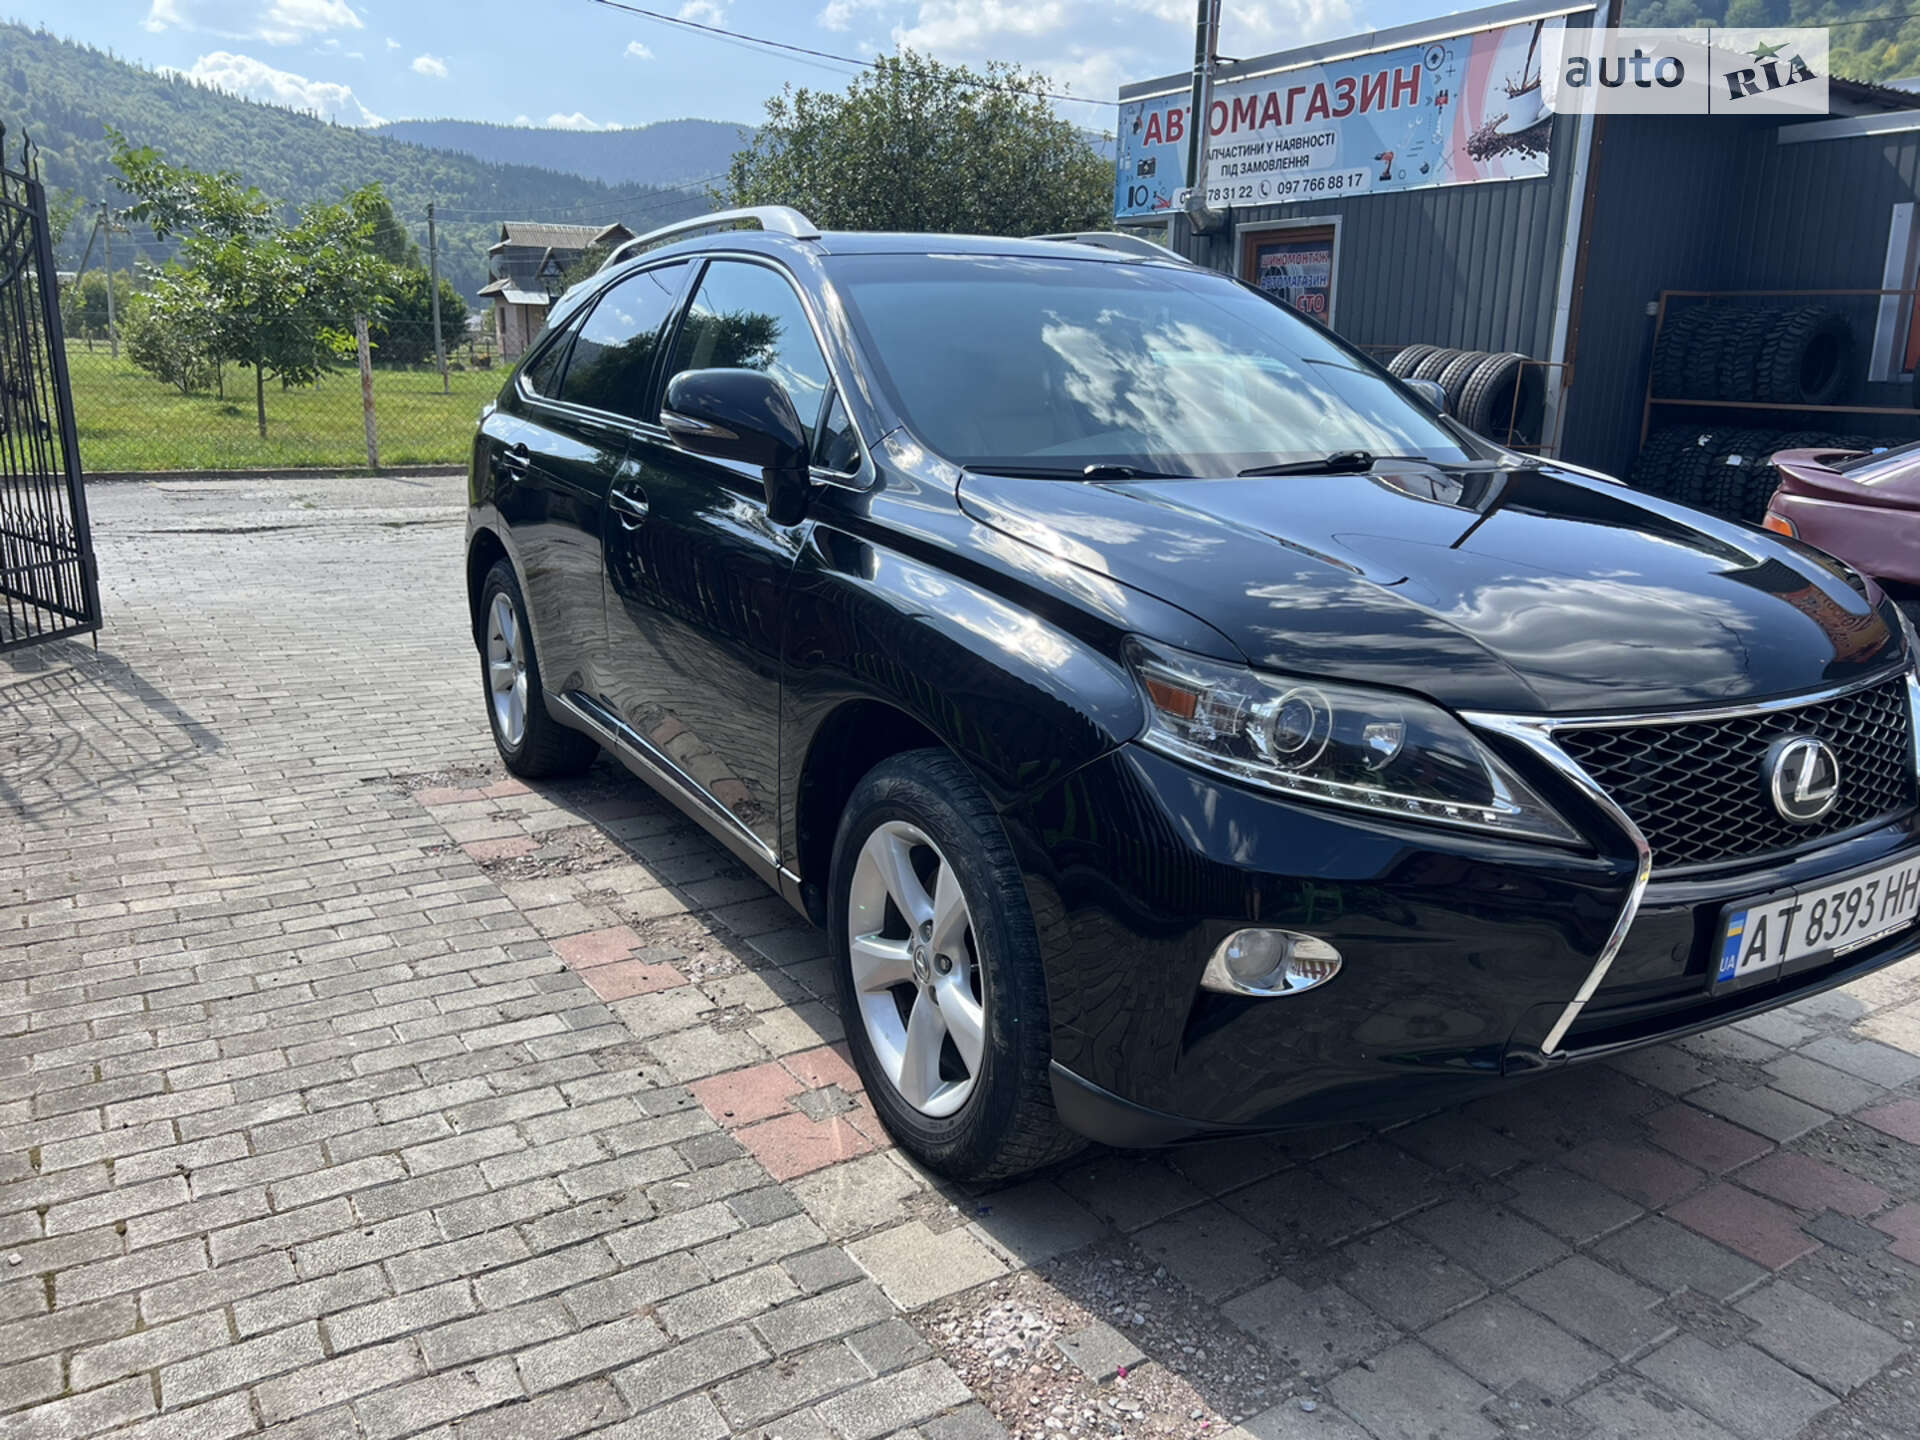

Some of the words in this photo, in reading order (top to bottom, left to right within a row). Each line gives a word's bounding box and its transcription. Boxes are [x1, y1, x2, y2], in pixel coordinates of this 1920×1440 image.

[1143, 64, 1421, 146] АВОМАГАЗИН
[1207, 143, 1264, 161] АПЧАСТИНИ
[1266, 141, 1273, 154] У
[1275, 132, 1335, 151] НАЯВНОСТІ
[1221, 163, 1238, 177] ПІД
[1240, 155, 1310, 174] ЗАМОВЛЕННЯ
[1222, 187, 1235, 200] 31
[1239, 185, 1253, 199] 22
[1277, 180, 1299, 195] 097
[1304, 177, 1325, 192] 766
[1328, 175, 1343, 189] 88
[1348, 173, 1363, 187] 17
[1296, 294, 1325, 313] СТО
[1805, 880, 1880, 947] 8393
[1720, 954, 1735, 972] UA
